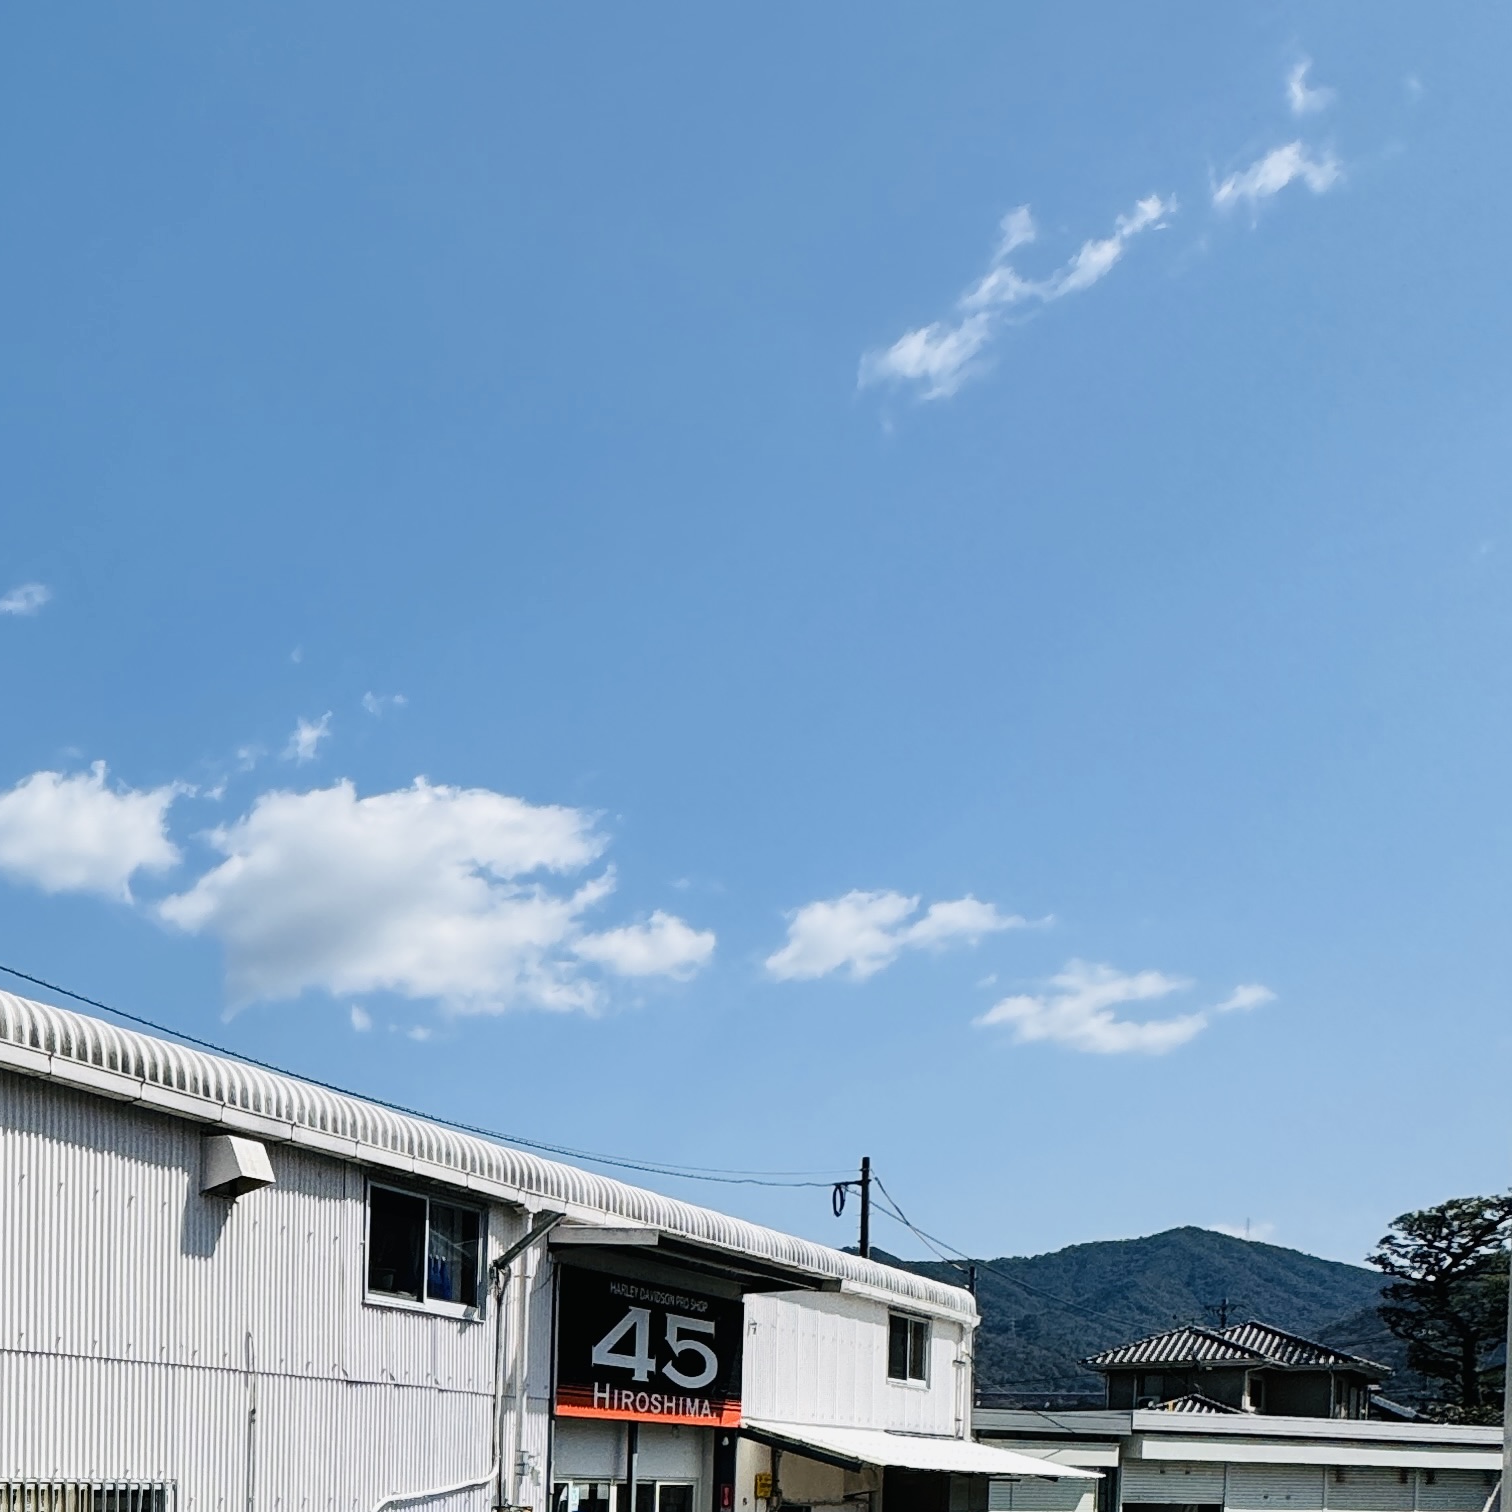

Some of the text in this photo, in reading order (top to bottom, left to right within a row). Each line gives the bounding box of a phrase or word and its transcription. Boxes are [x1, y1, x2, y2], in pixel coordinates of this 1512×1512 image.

[610, 1281, 639, 1298] HARLEY
[640, 1287, 675, 1306] DAVIDSON
[690, 1299, 709, 1313] SHOP
[591, 1306, 719, 1389] 45
